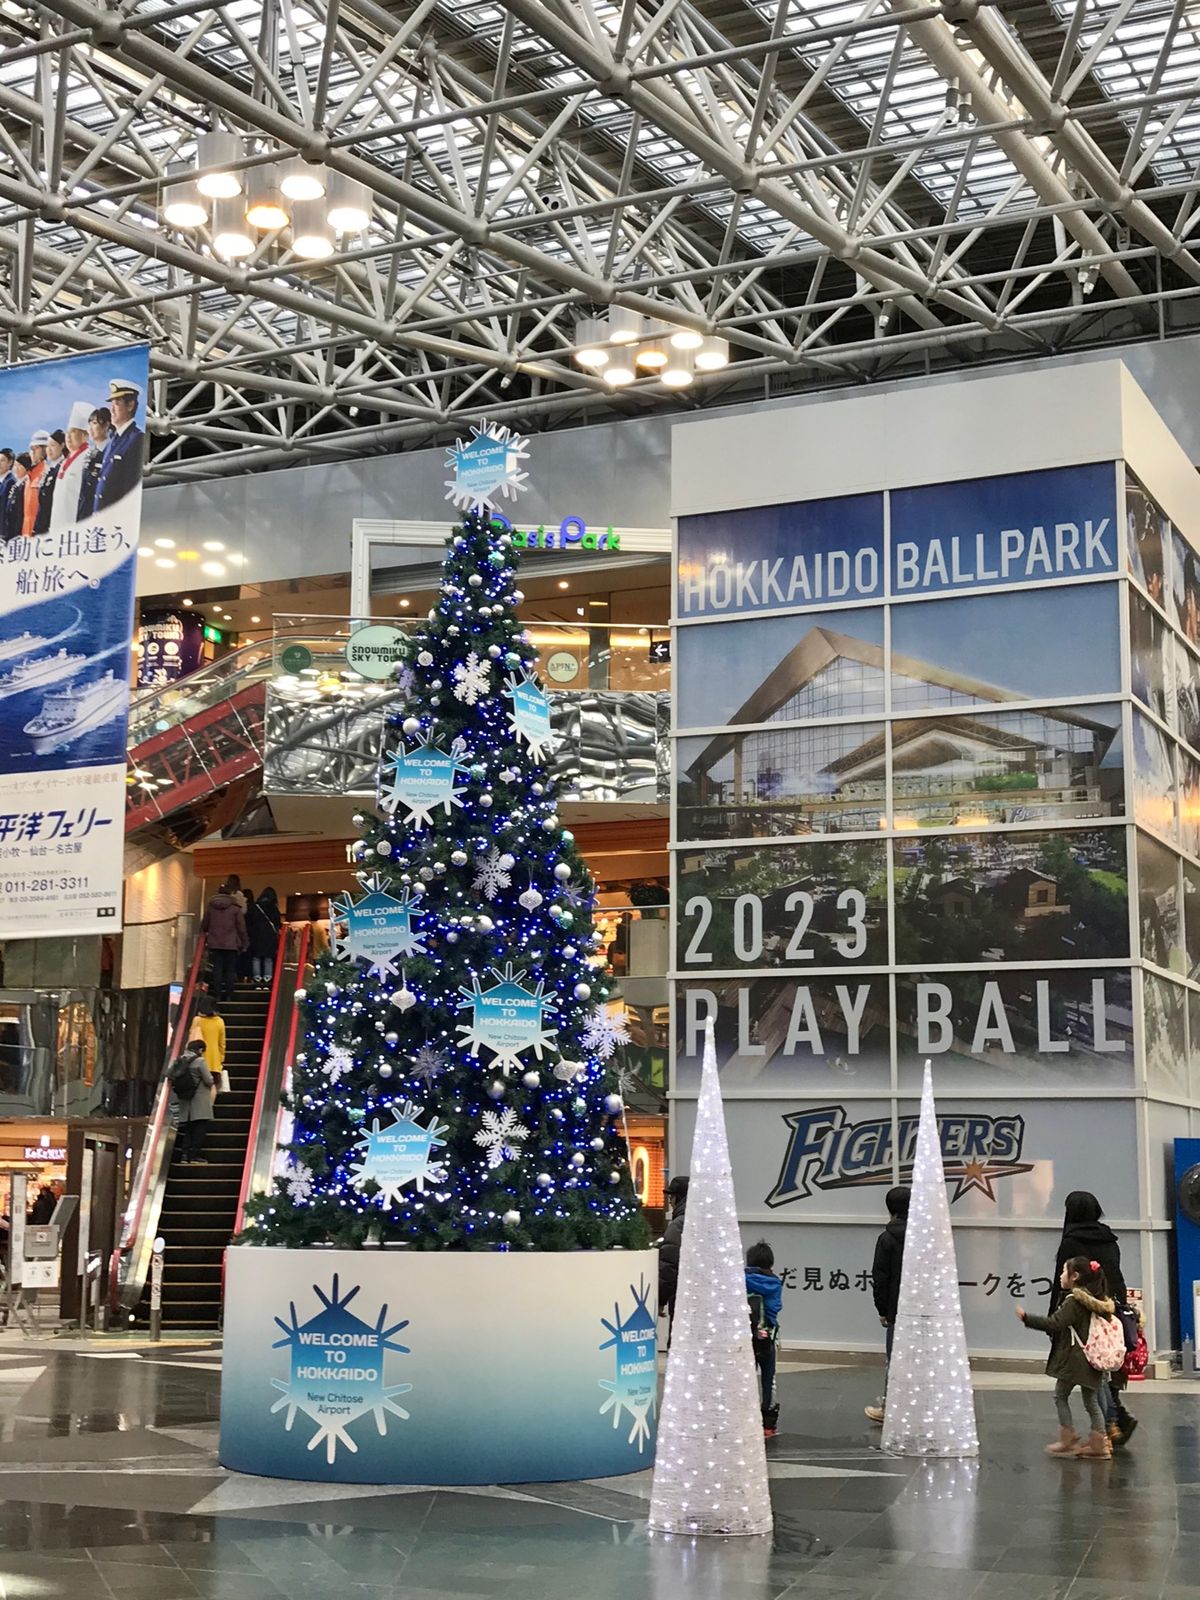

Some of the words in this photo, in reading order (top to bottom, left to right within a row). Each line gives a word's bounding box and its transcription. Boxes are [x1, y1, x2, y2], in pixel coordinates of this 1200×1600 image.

[462, 445, 505, 460] WELCOME
[477, 458, 489, 466] TO
[560, 515, 620, 550] Park
[0, 526, 131, 563] 動に出逢う、
[683, 547, 878, 612] HOKKAIDO
[897, 518, 1113, 590] BALLPARK
[16, 565, 100, 595] 船旅へ。
[404, 759, 452, 768] WELCOME
[420, 768, 433, 776] TO
[0, 807, 113, 842] 平洋フェリー
[5, 876, 88, 893] 011-281-3311
[353, 906, 405, 917] WELCOME
[372, 917, 386, 925] TO
[684, 888, 868, 963] 2023
[481, 997, 538, 1008] WELCOME
[501, 1008, 517, 1017] TO
[686, 984, 871, 1057] PLAY
[917, 978, 1126, 1055] BALL
[376, 1134, 430, 1144] WELCOME
[392, 1144, 407, 1152] TO
[764, 1105, 1024, 1208] FIGHERS
[299, 1333, 379, 1347] WELCOME
[621, 1328, 656, 1344] WELCOME
[324, 1350, 347, 1363] TO
[637, 1345, 647, 1358] TO
[296, 1366, 378, 1382] HOKKAIDO
[307, 1391, 325, 1402] New
[327, 1392, 364, 1404] Chitose
[317, 1404, 352, 1416] Airport
